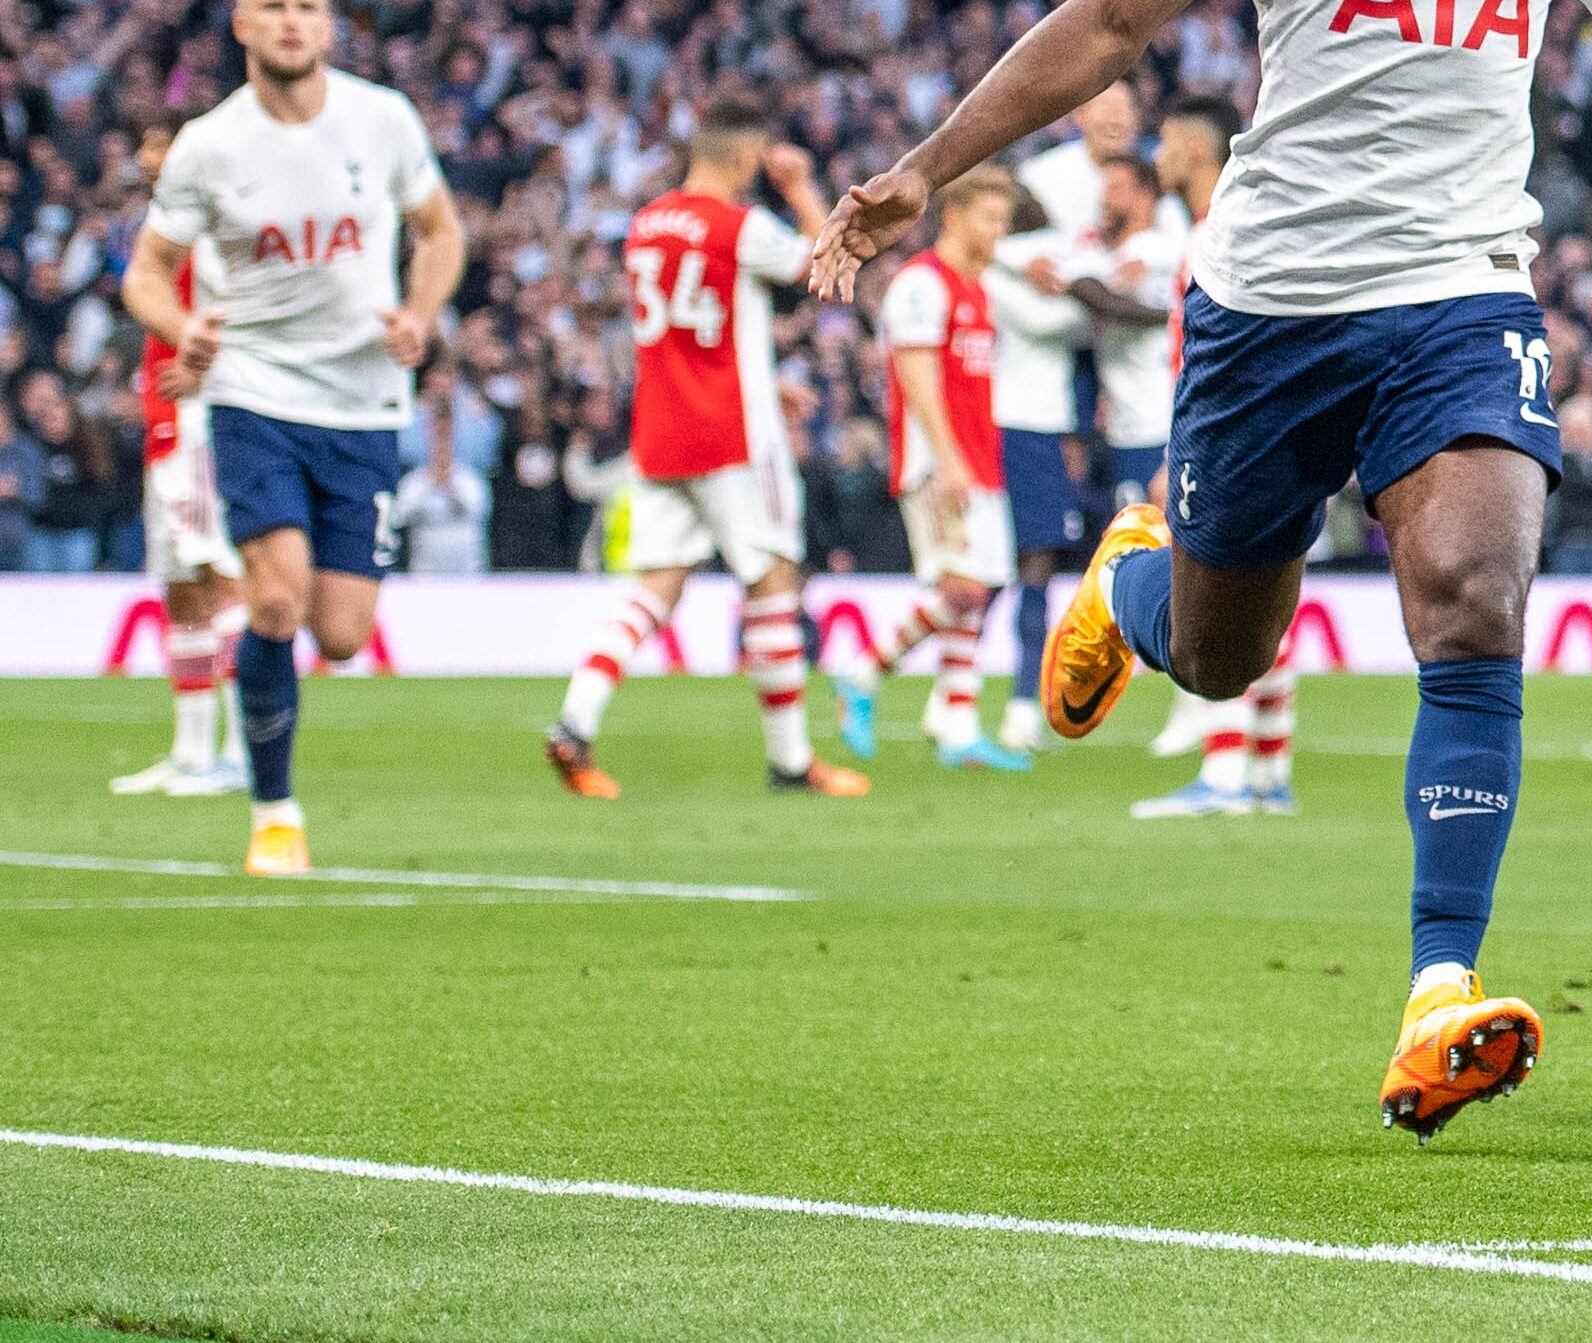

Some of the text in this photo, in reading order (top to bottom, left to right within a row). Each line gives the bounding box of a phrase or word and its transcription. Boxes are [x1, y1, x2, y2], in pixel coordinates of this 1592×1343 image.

[253, 216, 364, 264] AIA
[625, 247, 728, 349] 34
[1419, 784, 1510, 811] SPURS
